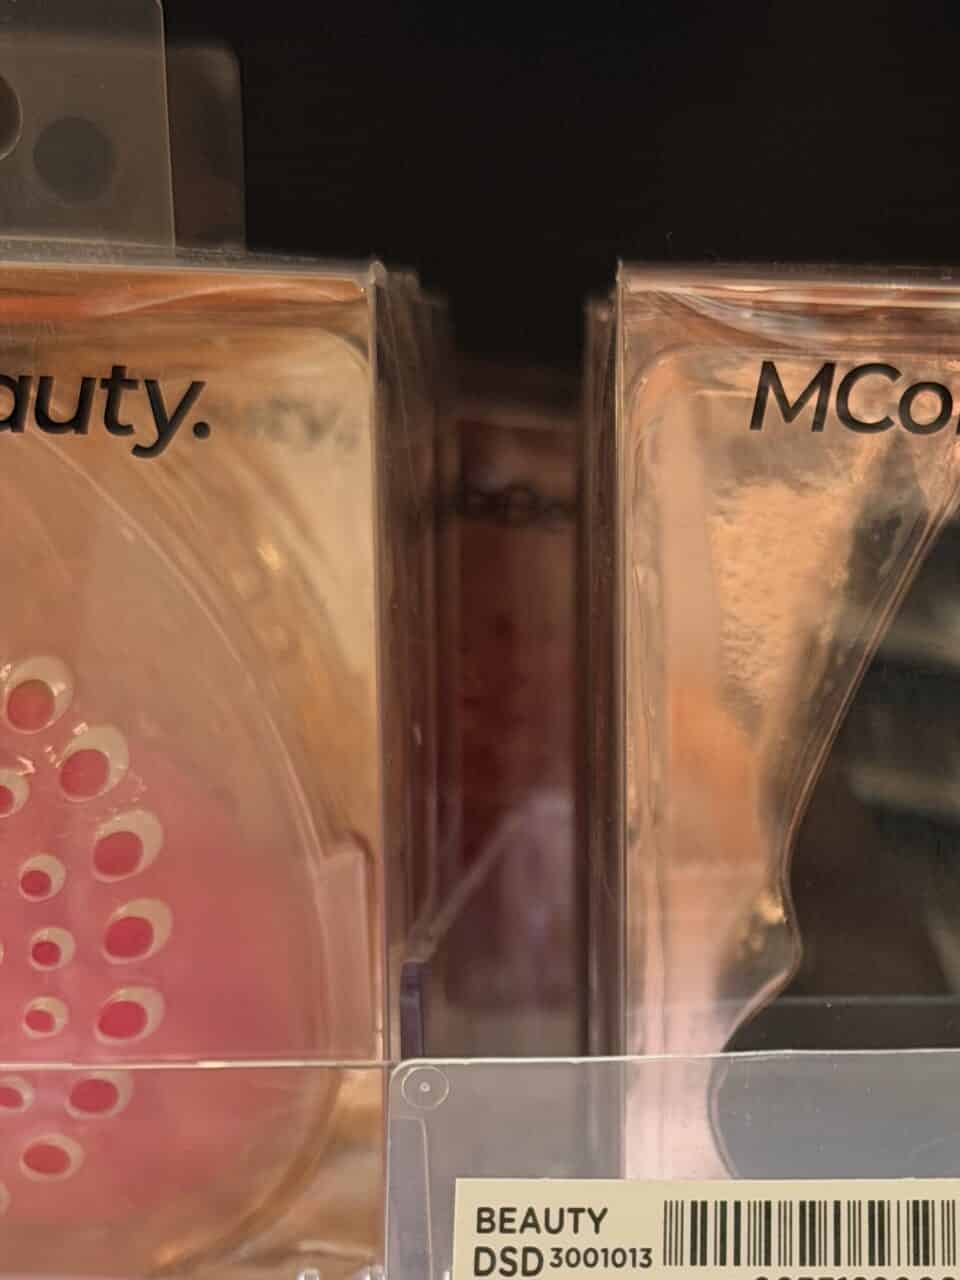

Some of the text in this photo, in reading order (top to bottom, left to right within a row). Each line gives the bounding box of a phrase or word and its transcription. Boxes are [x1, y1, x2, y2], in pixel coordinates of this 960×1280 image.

[475, 1205, 609, 1236] BEAUTY
[473, 1244, 654, 1279] DSD 3001013
